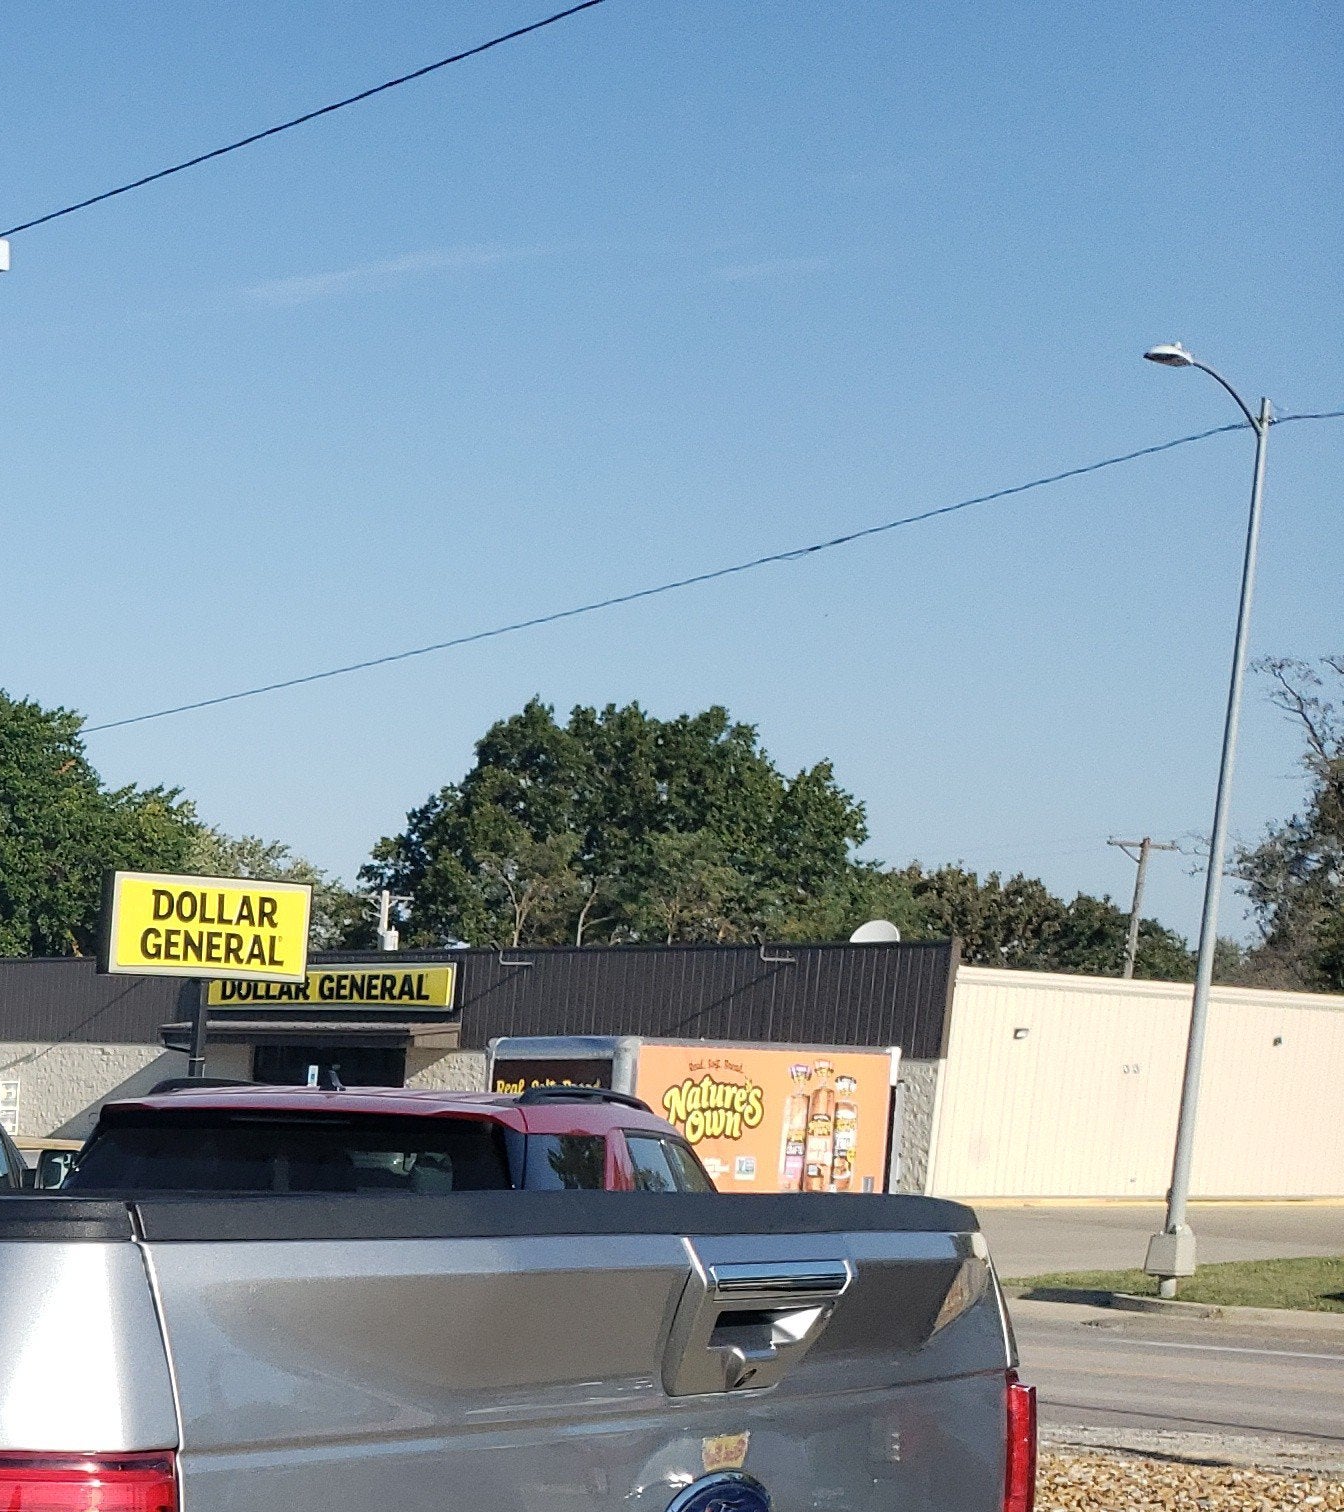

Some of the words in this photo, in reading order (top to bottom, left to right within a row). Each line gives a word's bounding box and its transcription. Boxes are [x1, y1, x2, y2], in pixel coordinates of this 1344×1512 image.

[152, 889, 279, 928] DOLLAR
[140, 927, 285, 967] GENERAL
[220, 976, 311, 1001] DOLLAR
[318, 974, 430, 1001] GENERAL
[662, 1074, 764, 1129] Nature's
